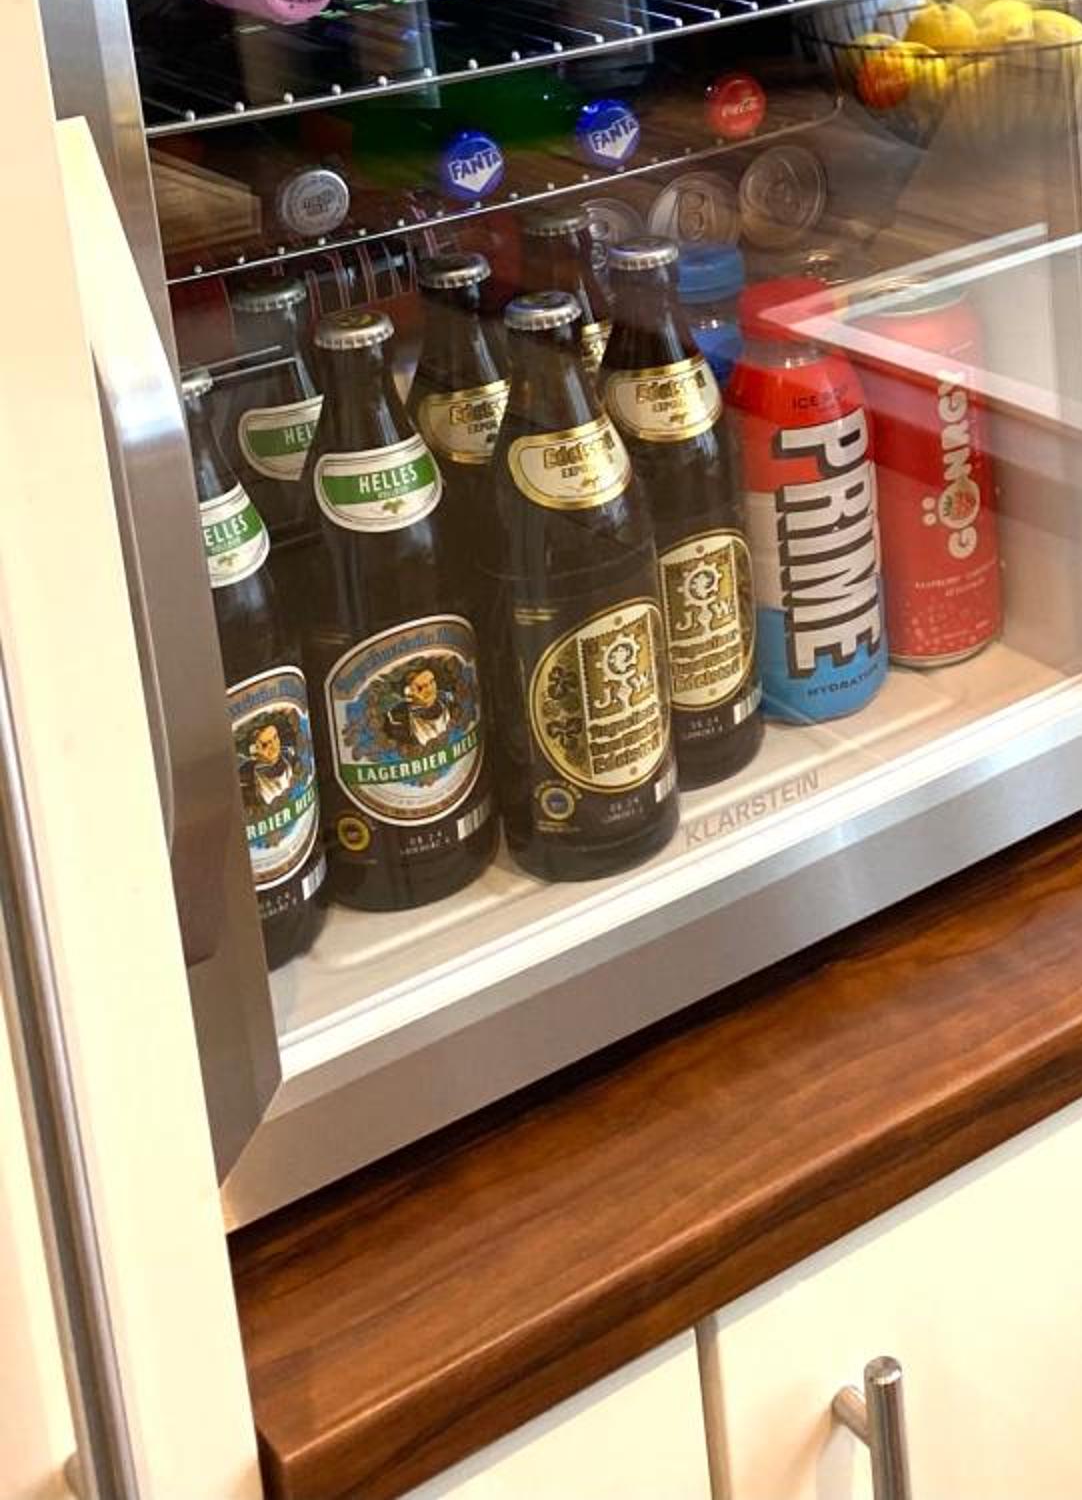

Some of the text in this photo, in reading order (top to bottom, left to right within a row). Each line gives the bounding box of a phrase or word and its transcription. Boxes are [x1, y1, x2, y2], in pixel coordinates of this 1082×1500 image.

[592, 117, 639, 151] FANTA
[452, 150, 500, 181] FANTA
[283, 425, 314, 446] HEL
[358, 463, 419, 494] HELLES
[203, 513, 248, 547] ELLES
[772, 407, 882, 679] PRIME
[357, 749, 448, 783] LAGERBIER
[683, 767, 820, 846] KLARSTEIN
[245, 809, 293, 842] RBIER
